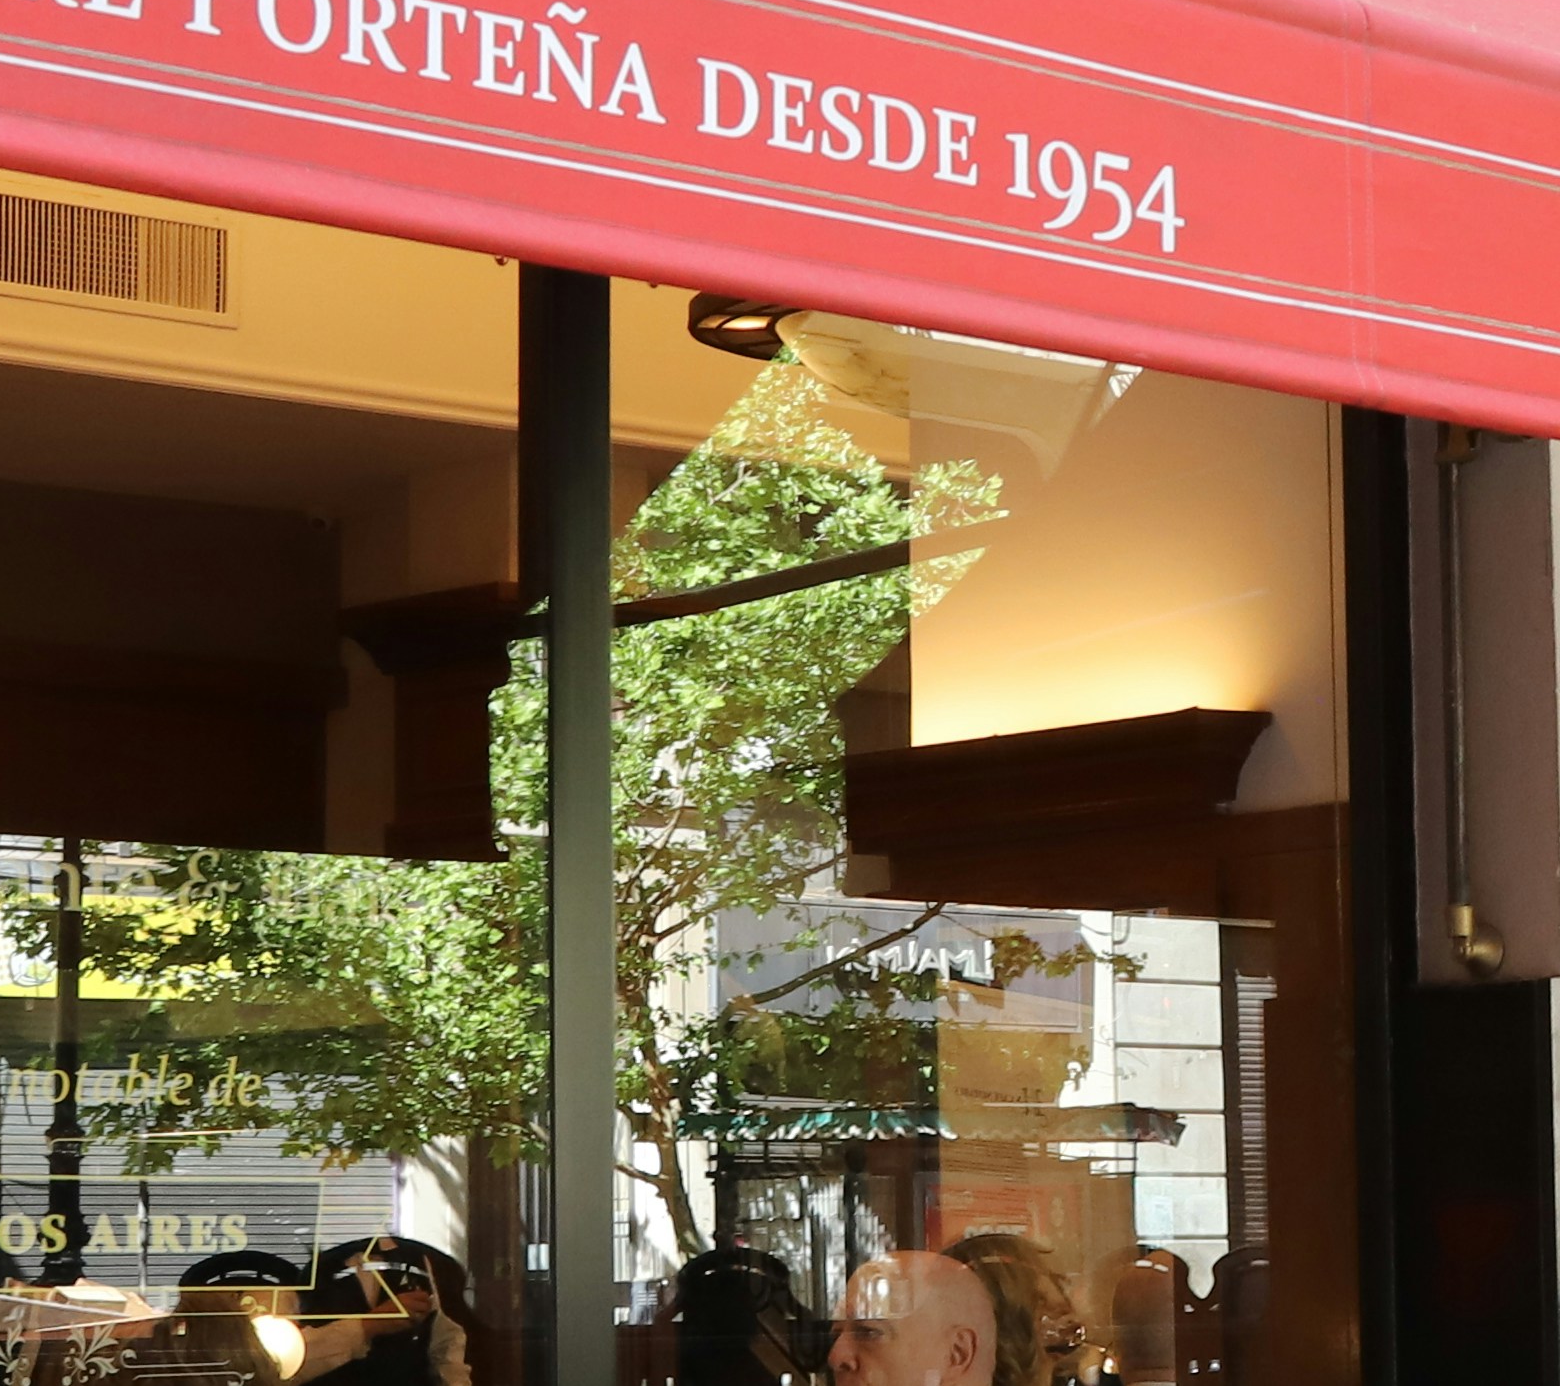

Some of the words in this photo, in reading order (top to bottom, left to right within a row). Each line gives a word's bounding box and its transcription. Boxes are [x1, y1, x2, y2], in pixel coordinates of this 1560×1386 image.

[696, 57, 978, 187] DESDE
[1004, 133, 1186, 253] 1954
[10, 1053, 194, 1107] notable
[207, 1054, 264, 1108] de
[84, 1211, 249, 1255] AIRES
